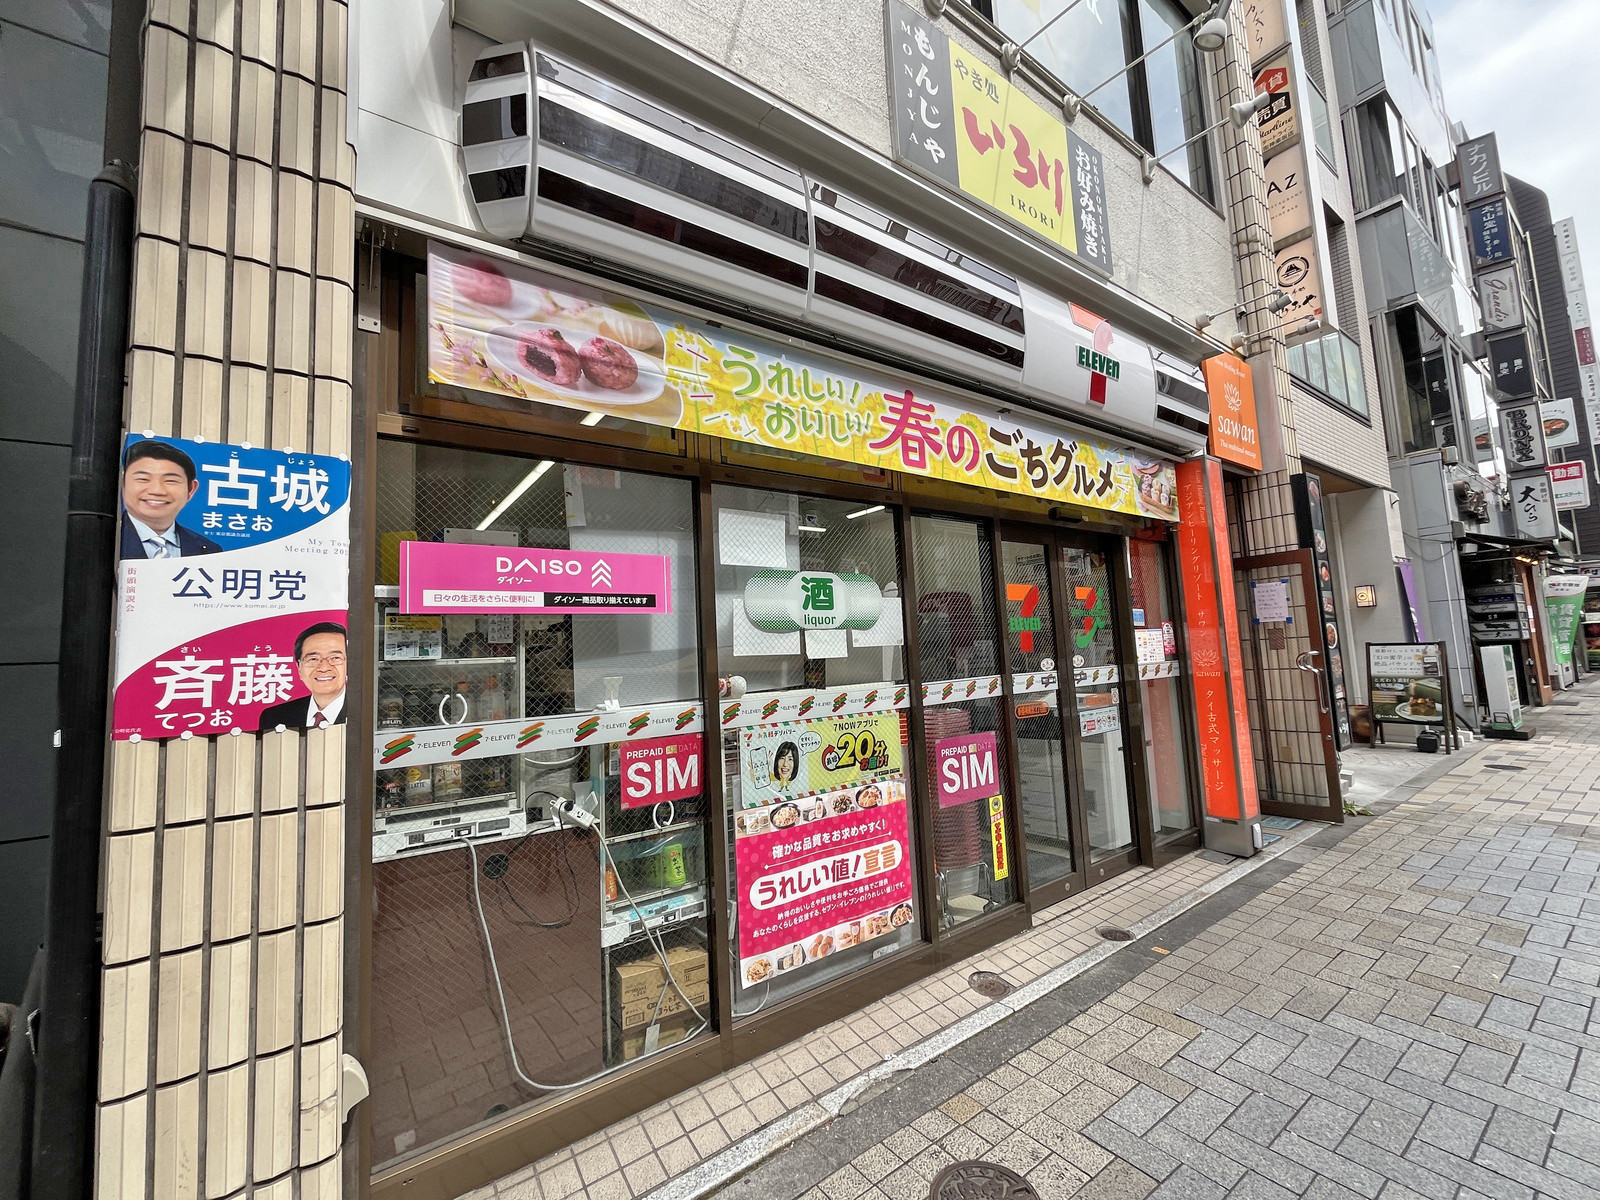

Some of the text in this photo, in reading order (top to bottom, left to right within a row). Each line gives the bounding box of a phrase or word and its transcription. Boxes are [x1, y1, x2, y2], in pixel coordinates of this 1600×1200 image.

[901, 20, 919, 145] MONJYA
[954, 57, 1000, 104] やき処
[961, 106, 1065, 217] いろり
[1467, 143, 1493, 195] ナカノビル
[1010, 195, 1056, 230] IRORI
[1075, 145, 1098, 258] お好み焼き
[1092, 155, 1107, 265] OKONOMIYAKI
[723, 345, 860, 405] うれしい!
[869, 389, 1114, 498] 春のごちグルメ
[1218, 415, 1255, 445] sawan
[1505, 408, 1535, 463] BRONX
[287, 457, 315, 466] じょう
[201, 458, 331, 515] 古城
[202, 512, 274, 532] まさお
[284, 545, 328, 555] Meeting
[308, 538, 324, 546] My
[1184, 484, 1206, 637] アジアンヒーリングリゾート サワン
[172, 566, 307, 601] 公明党
[496, 556, 582, 576] DAISO
[497, 576, 532, 585] ダイソー
[193, 602, 287, 610] https://www.komei.or.jp
[433, 593, 535, 604] 日々の生活をさらに便利に!
[553, 595, 649, 605] ダイソー商品取り揃えています
[800, 576, 835, 611] 酒
[804, 614, 837, 627] liquor
[153, 653, 295, 710] 斉藤
[154, 709, 234, 730] てつお
[626, 743, 698, 760] PREPAID DATA
[941, 745, 968, 757] PREPAID
[1206, 690, 1225, 791] タイ古式マッサージ
[627, 755, 699, 798] SIM
[942, 751, 994, 794] SIM
[772, 819, 886, 860] 確かな品質をお求めやすく!
[758, 844, 897, 906] うれしい値!宣言
